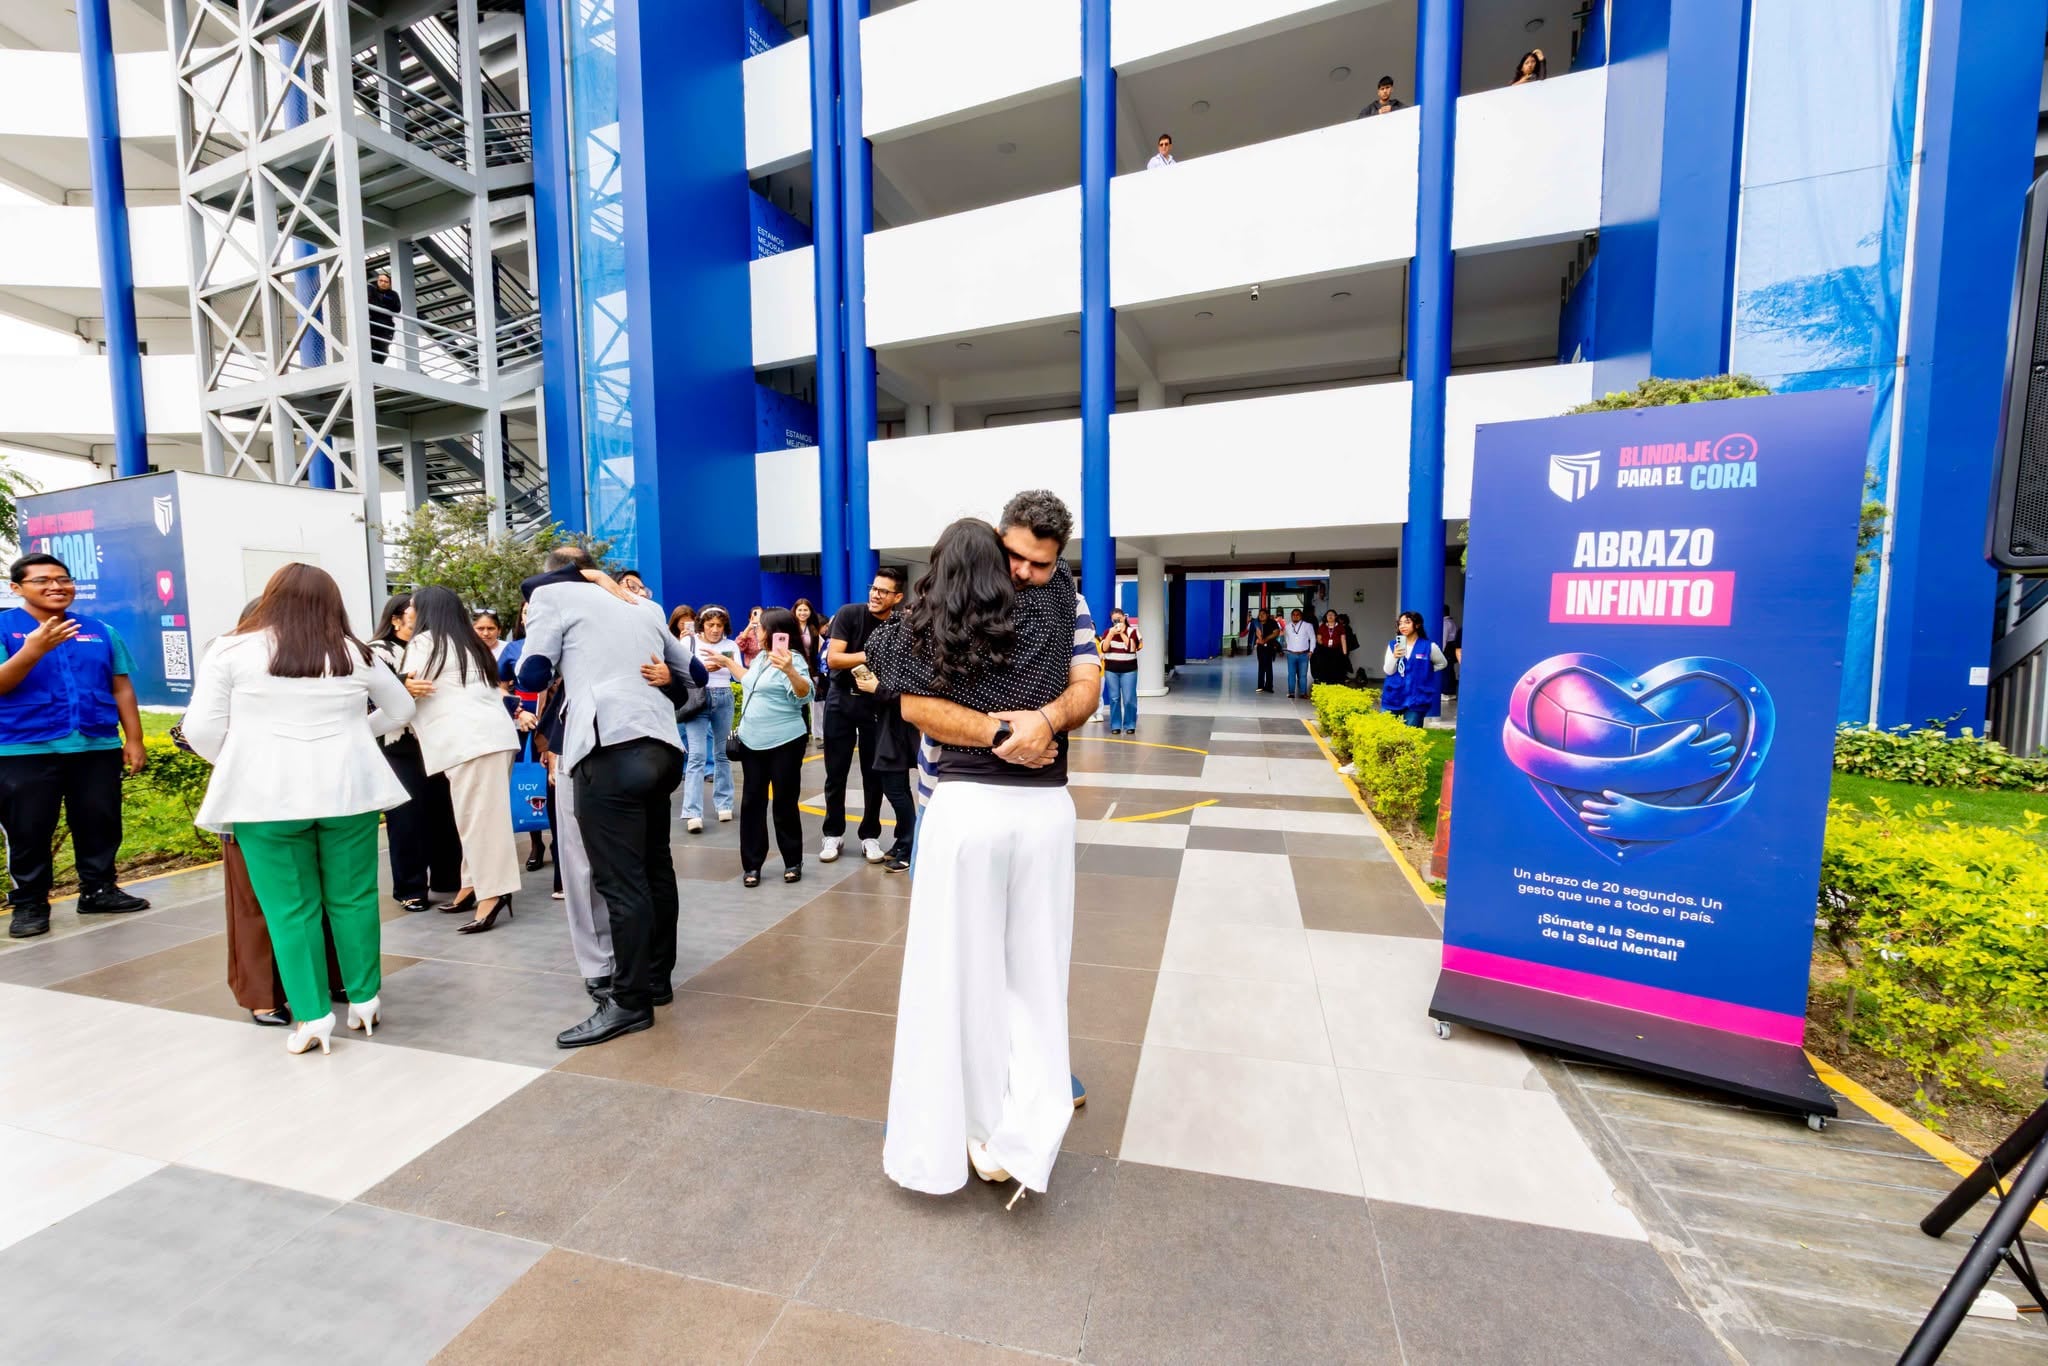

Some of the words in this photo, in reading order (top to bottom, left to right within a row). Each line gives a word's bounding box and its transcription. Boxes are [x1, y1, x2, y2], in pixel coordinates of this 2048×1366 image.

[757, 226, 785, 247] ESTAMOS
[785, 429, 812, 443] ESTAMOS
[1619, 440, 1712, 467] BLINDAJE
[1617, 467, 1662, 488] PARA
[1666, 465, 1683, 486] EL
[1690, 461, 1757, 491] CORA
[1573, 528, 1715, 568] ABRAZO
[1565, 579, 1715, 617] INFINITO
[518, 783, 538, 791] UCV
[1513, 867, 1531, 880] Un
[1535, 872, 1579, 887] abrazo
[1581, 879, 1599, 891] de
[1602, 881, 1620, 894] 20
[1623, 886, 1697, 906] segundos.
[1701, 897, 1722, 910] Un
[1518, 883, 1554, 897] gesto
[1557, 888, 1582, 901] que
[1585, 894, 1611, 907] une
[1614, 900, 1622, 909] a
[1626, 899, 1659, 915] todo
[1663, 907, 1675, 918] el
[1679, 910, 1714, 926] país.
[1538, 913, 1594, 932] ¡Súmate
[1597, 925, 1606, 934] a
[1609, 925, 1622, 937] la
[1625, 928, 1685, 948] Semana
[1542, 927, 1559, 939] de
[1563, 929, 1574, 942] la
[1578, 933, 1618, 950] Salud
[1622, 942, 1677, 961] Mental!
